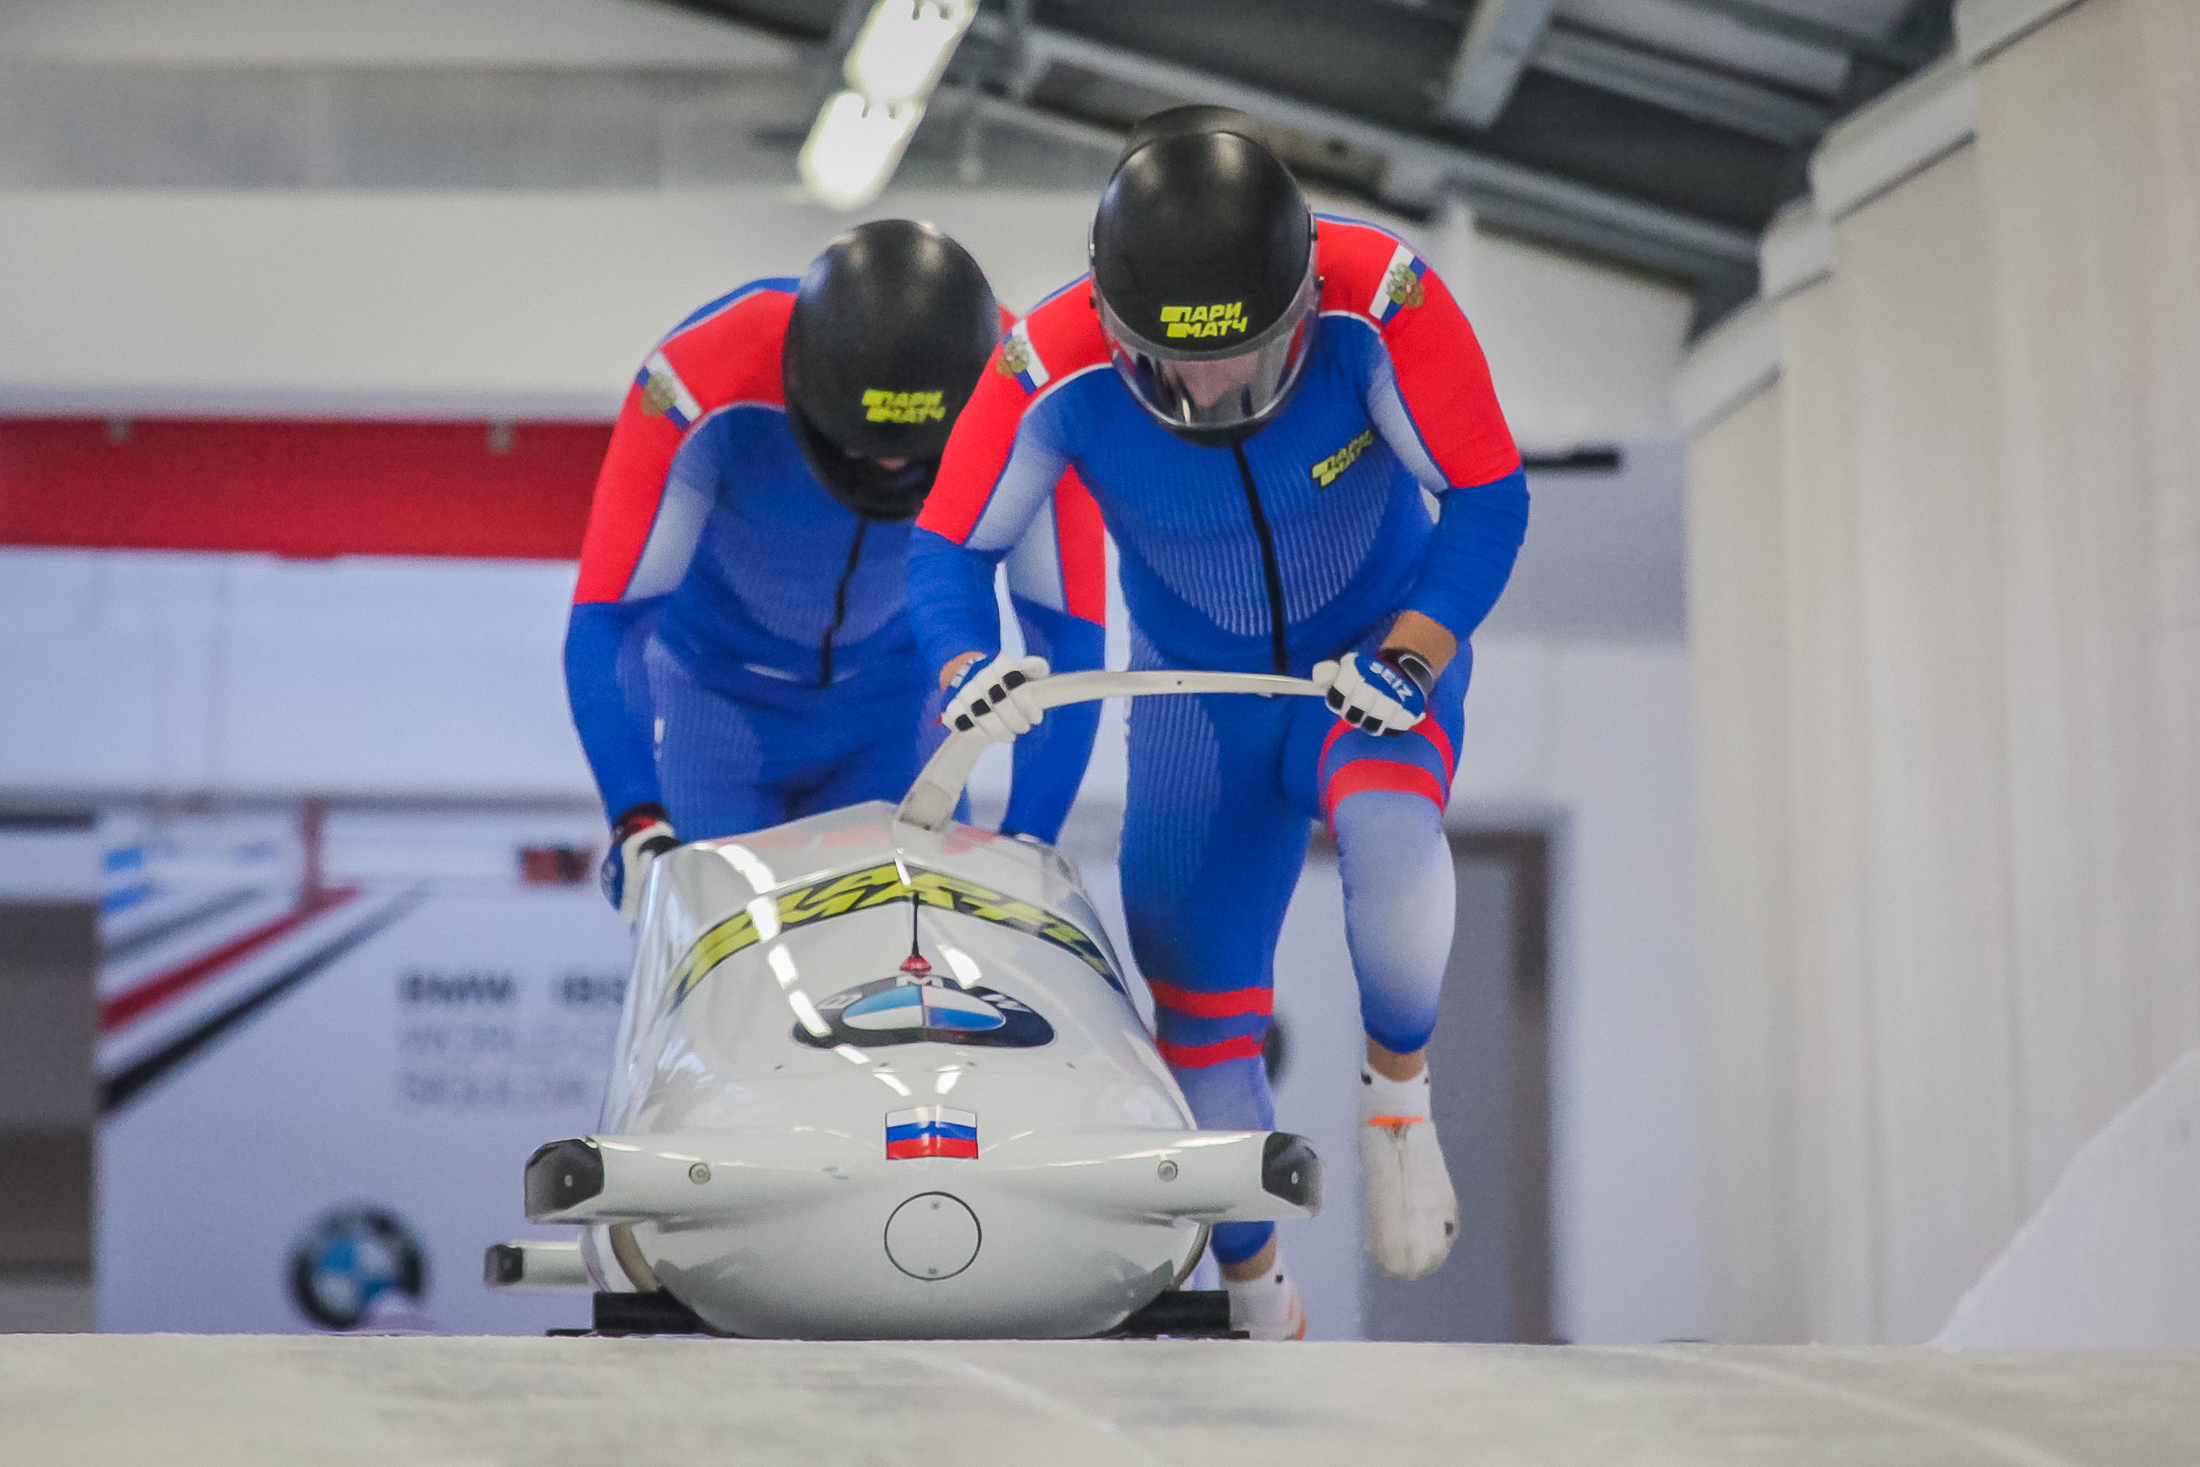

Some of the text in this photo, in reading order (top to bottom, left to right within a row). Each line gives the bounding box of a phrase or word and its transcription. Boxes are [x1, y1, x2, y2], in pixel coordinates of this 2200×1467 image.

[1160, 302, 1242, 322] ПАРИ
[1166, 316, 1248, 338] МАТЧ
[1370, 661, 1414, 702] SEIZ
